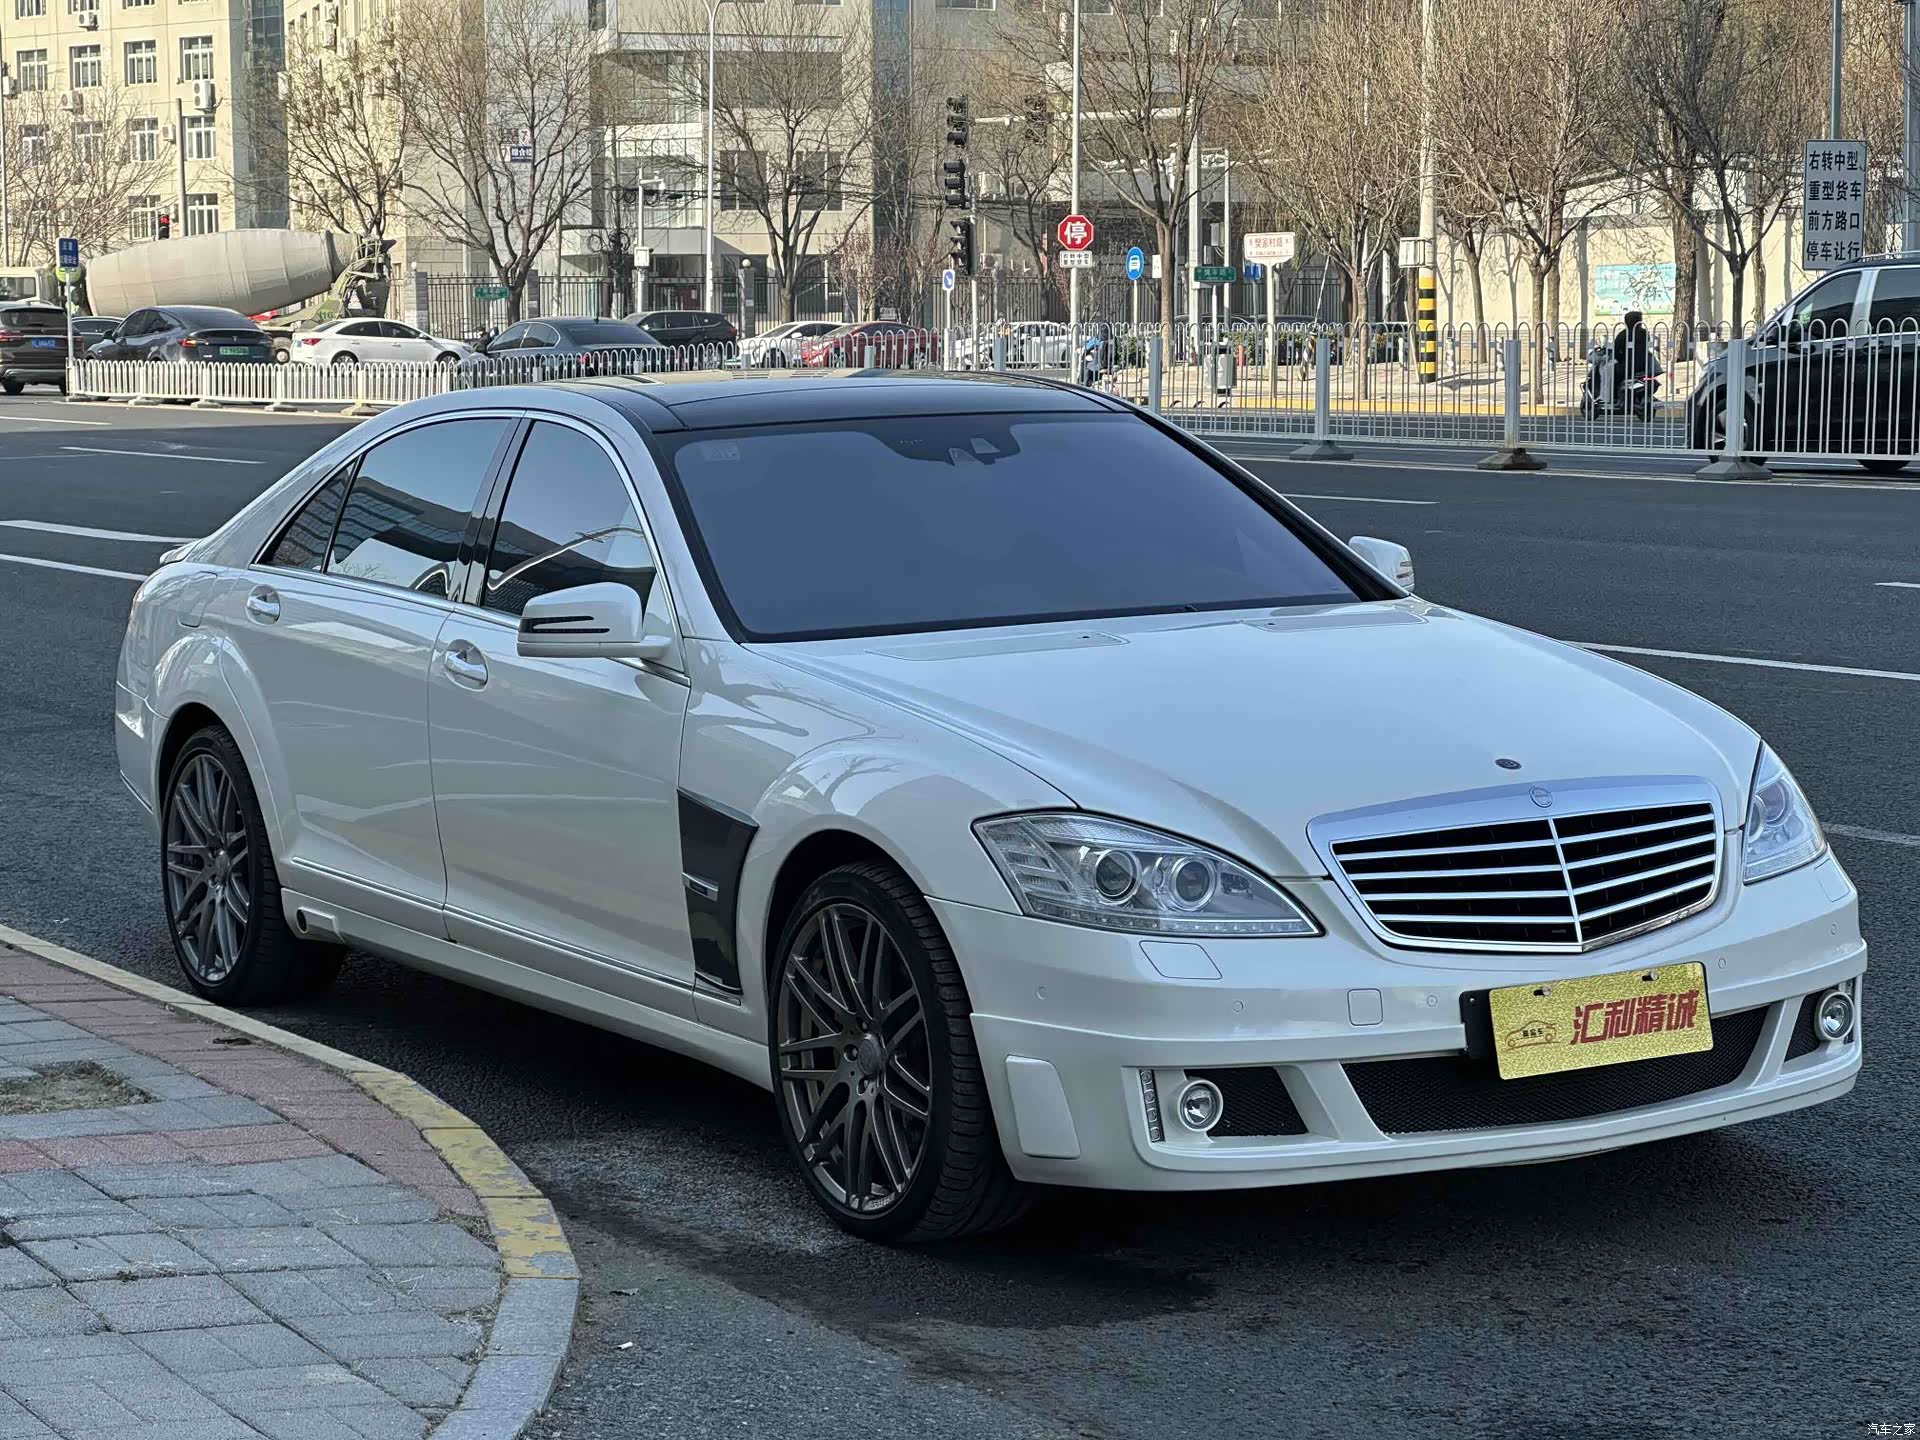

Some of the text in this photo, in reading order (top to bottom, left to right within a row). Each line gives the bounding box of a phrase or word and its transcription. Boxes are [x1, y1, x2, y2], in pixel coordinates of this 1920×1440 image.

[1809, 180, 1861, 201] 重型货车
[1808, 210, 1859, 231] 前方路口
[1064, 221, 1087, 244] 停
[1806, 241, 1859, 261] 停车让行
[1570, 989, 1699, 1045] 汇利精诚
